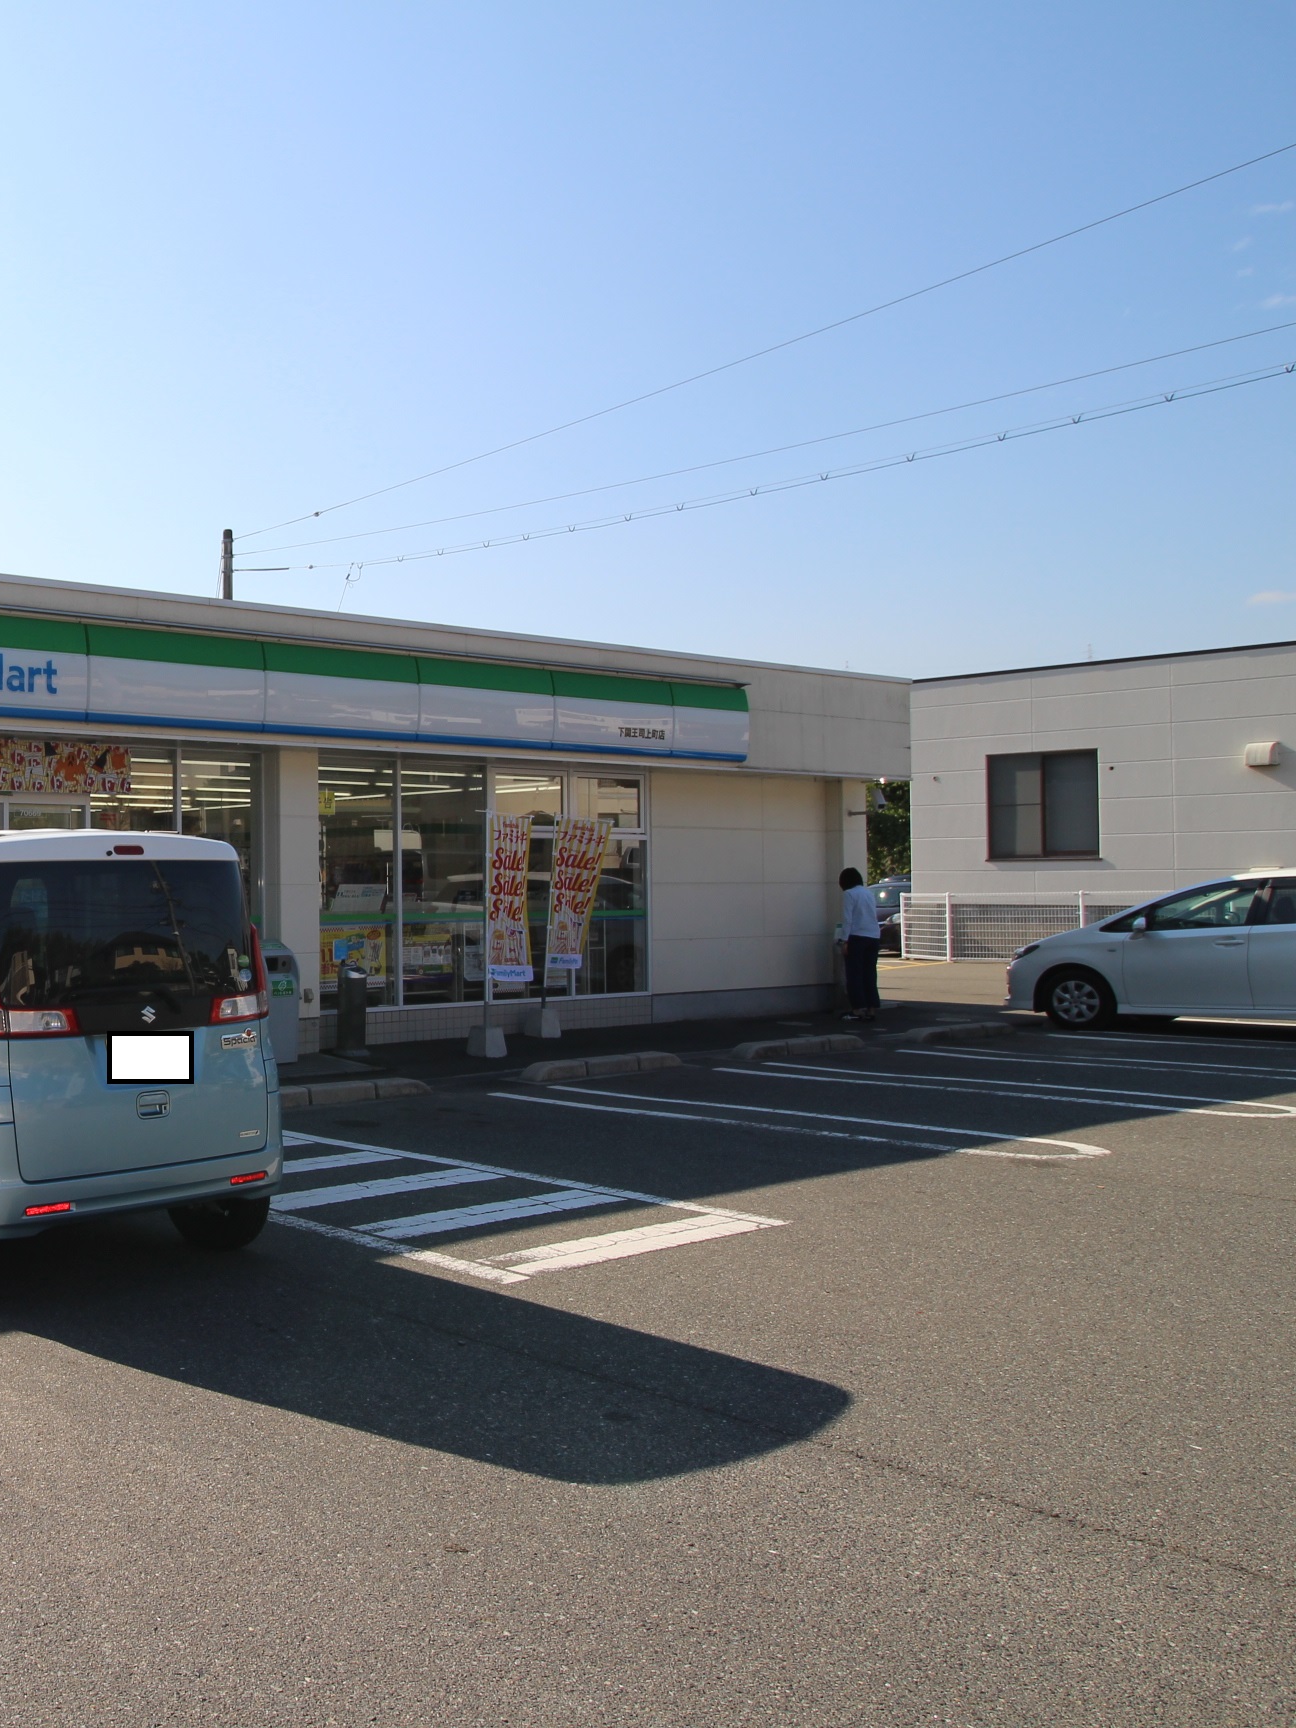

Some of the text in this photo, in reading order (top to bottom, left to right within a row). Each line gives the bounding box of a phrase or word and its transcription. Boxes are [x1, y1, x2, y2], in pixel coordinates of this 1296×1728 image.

[618, 727, 665, 740] 下関王司上町店
[493, 829, 527, 844] ファミチキ
[560, 831, 605, 847] ファミチキ
[492, 847, 526, 872] Sale!
[556, 847, 602, 871] Sale!
[490, 872, 525, 897] Sale!
[555, 870, 597, 893] Sale!
[223, 1036, 256, 1047] Spacia
